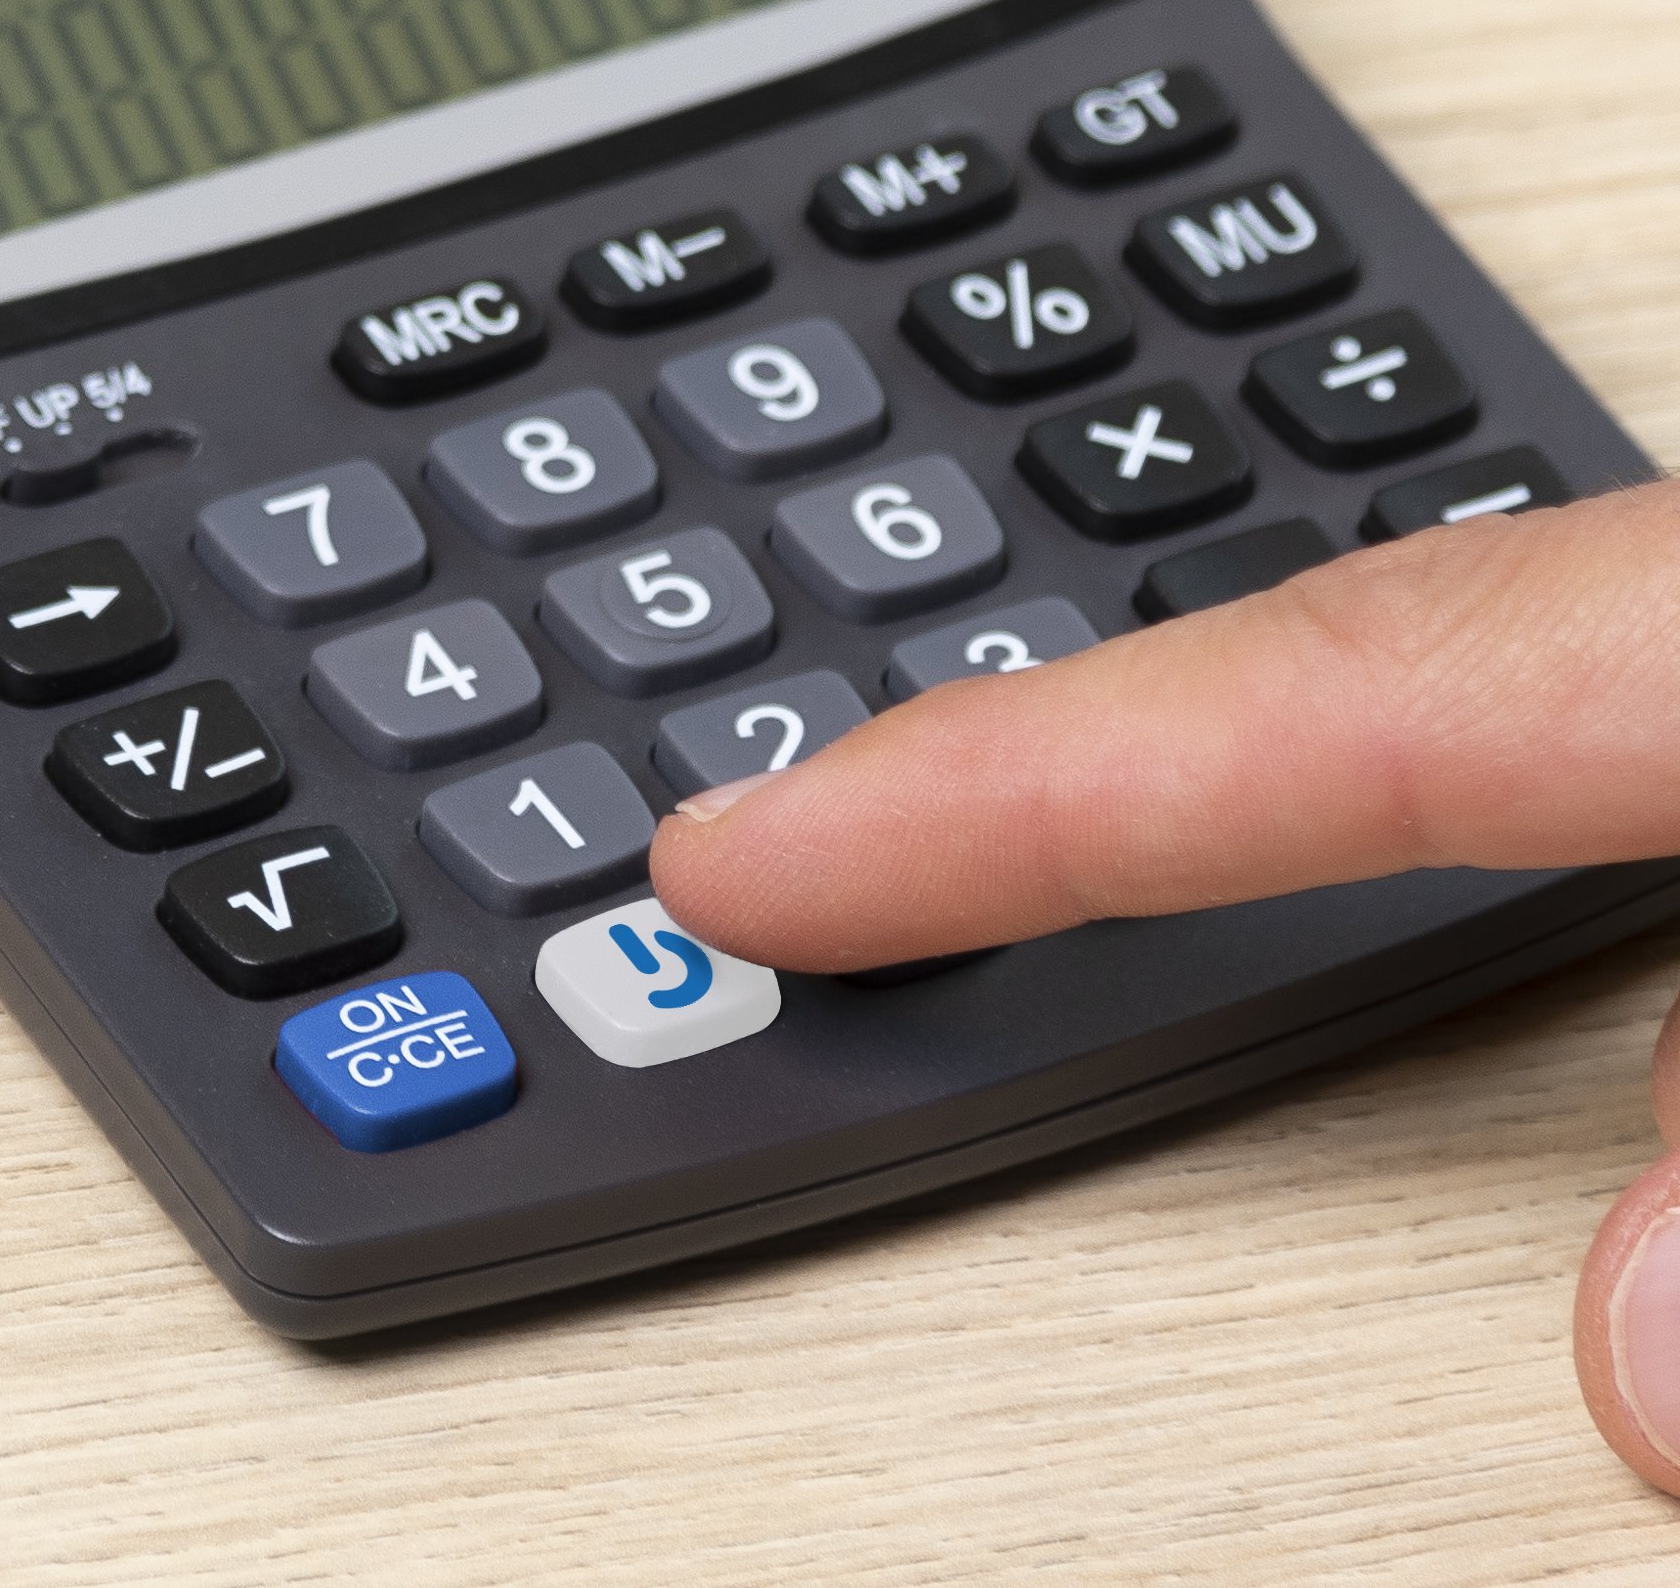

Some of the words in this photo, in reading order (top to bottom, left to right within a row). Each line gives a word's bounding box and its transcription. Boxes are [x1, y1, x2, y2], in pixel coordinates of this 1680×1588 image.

[1077, 75, 1176, 143] GT
[844, 149, 964, 214] M+
[1172, 188, 1316, 276] MU
[363, 284, 519, 364] MRC
[12, 381, 80, 429] UP
[80, 361, 153, 410] 5/4
[731, 347, 818, 421] 9
[504, 418, 595, 493] 8
[265, 486, 338, 565] 7
[853, 485, 941, 559] 6
[621, 553, 710, 627] 5
[406, 631, 477, 700] 4
[735, 702, 805, 773] 2
[510, 780, 585, 848] 1
[339, 984, 428, 1034] ON
